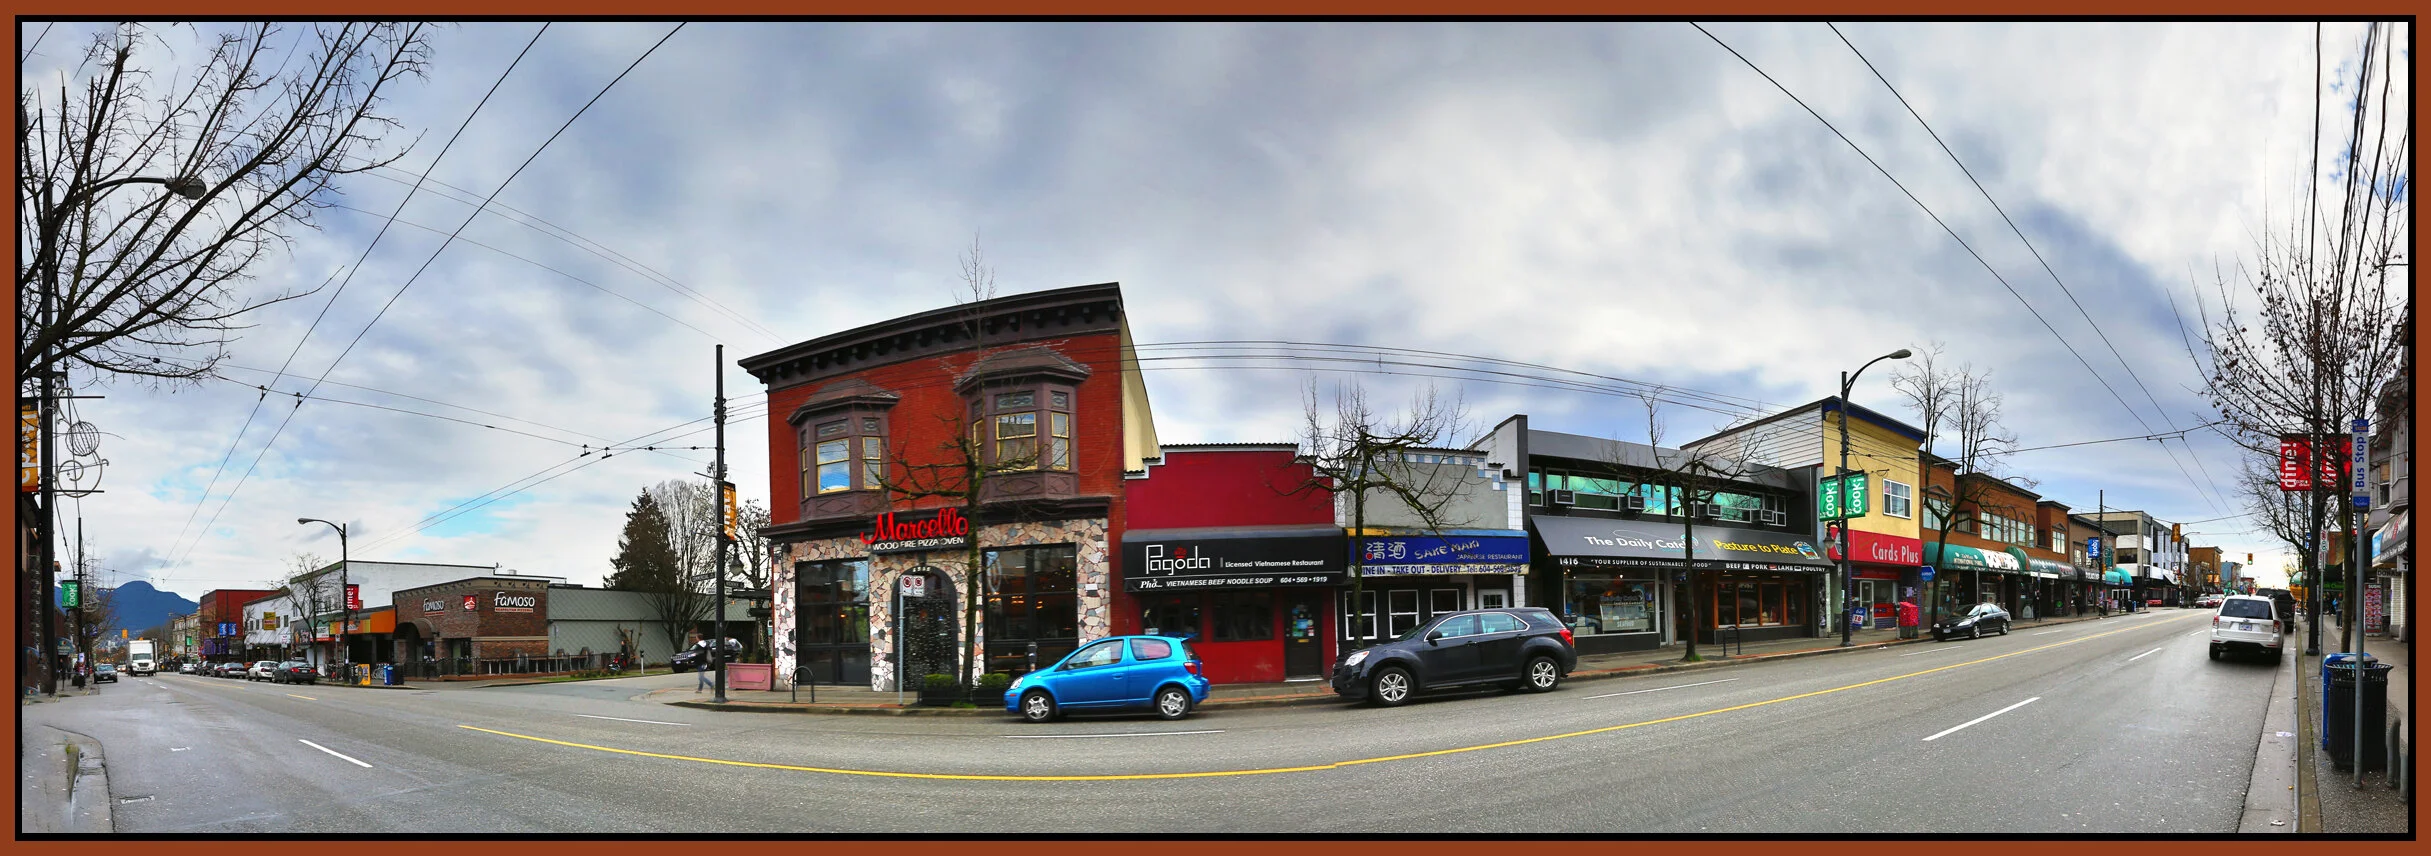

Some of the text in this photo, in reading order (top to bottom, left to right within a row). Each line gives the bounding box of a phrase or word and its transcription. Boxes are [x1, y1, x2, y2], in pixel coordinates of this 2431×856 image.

[2355, 436, 2367, 463] Stop
[2280, 442, 2297, 488] dine!
[2355, 466, 2365, 487] Bus
[860, 507, 969, 544] Marcello
[872, 537, 964, 551] WOOD FIRE PIZZA OVEN
[1366, 541, 1406, 560] 清酒
[1414, 540, 1480, 560] SAKE MAKI
[1583, 536, 1687, 549] The Daily Catc
[1713, 539, 1758, 552] Pasture
[1757, 543, 1771, 553] to
[1770, 544, 1799, 555] Plate
[1145, 544, 1211, 575] Pagoda
[1559, 557, 1579, 565] 1416
[1872, 542, 1919, 564] Cards Plus
[1362, 566, 1376, 575] INE
[1376, 566, 1385, 574] IN
[1392, 566, 1409, 574] TAKE
[1411, 565, 1426, 574] OUT
[1431, 565, 1461, 574] DELIVERY
[1166, 579, 1207, 587] VIETNAMESE
[1207, 578, 1226, 586] BEEF
[1226, 577, 1254, 585] NOODLE
